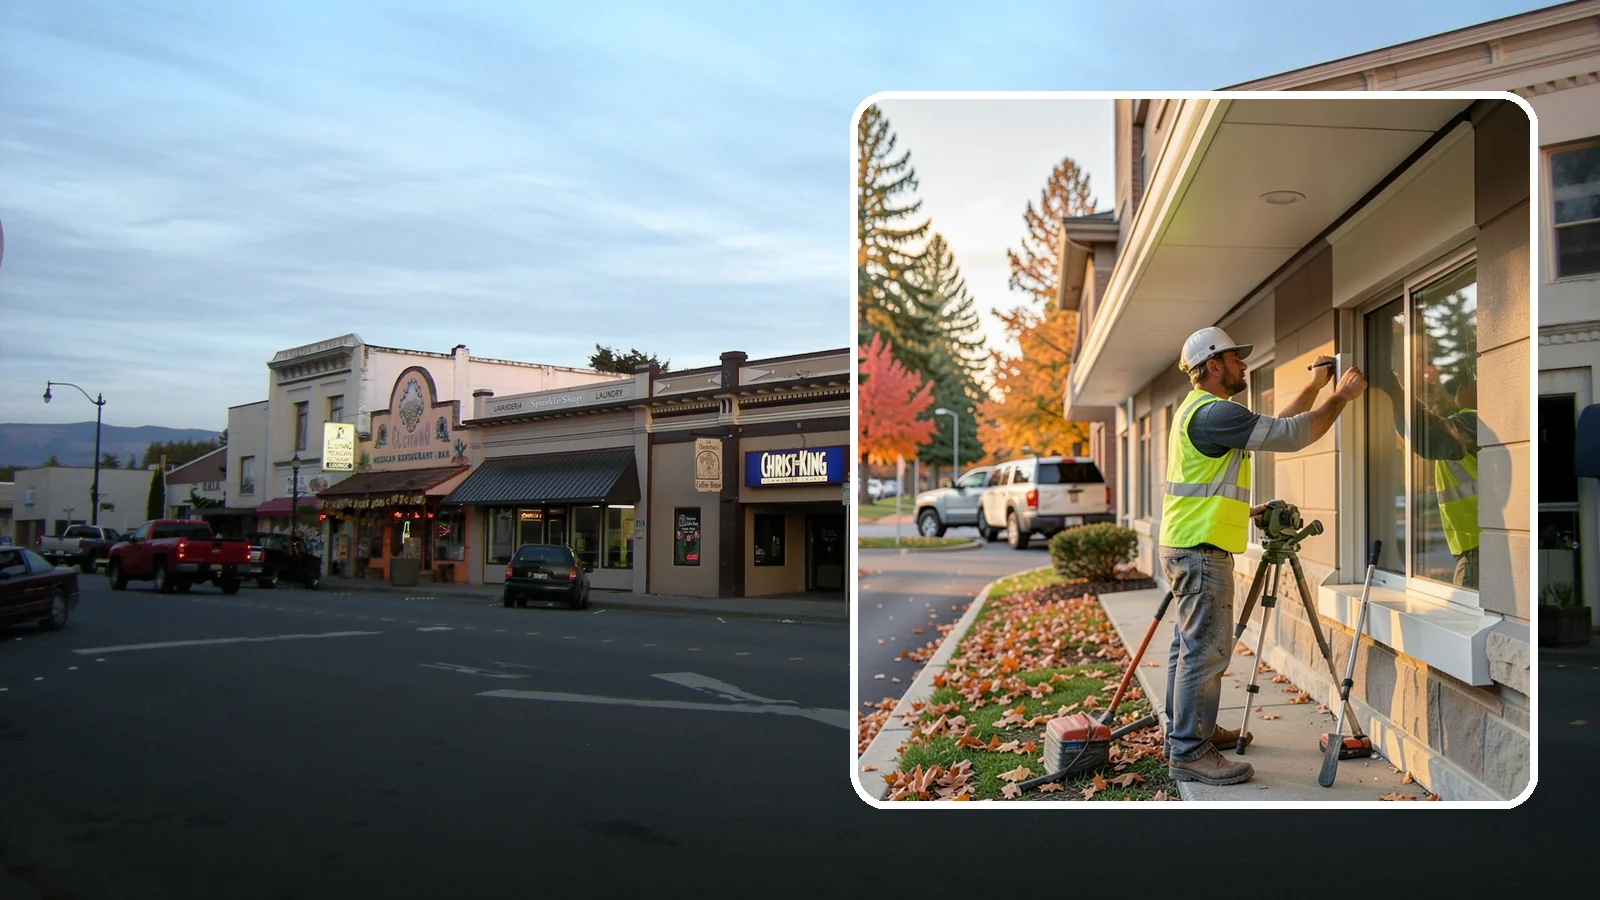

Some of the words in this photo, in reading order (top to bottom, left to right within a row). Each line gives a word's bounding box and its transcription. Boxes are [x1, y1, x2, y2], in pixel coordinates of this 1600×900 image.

[531, 396, 561, 408] Sparkle
[562, 394, 582, 404] Shop
[595, 389, 624, 400] LAUNDRY
[493, 402, 523, 413] LAVANDERIA
[392, 425, 401, 449] EL
[373, 454, 396, 464] MEXICAN
[397, 451, 433, 462] RESTAURANT
[437, 450, 450, 459] BAR
[761, 451, 797, 478] CHRIST
[799, 449, 828, 476] KING
